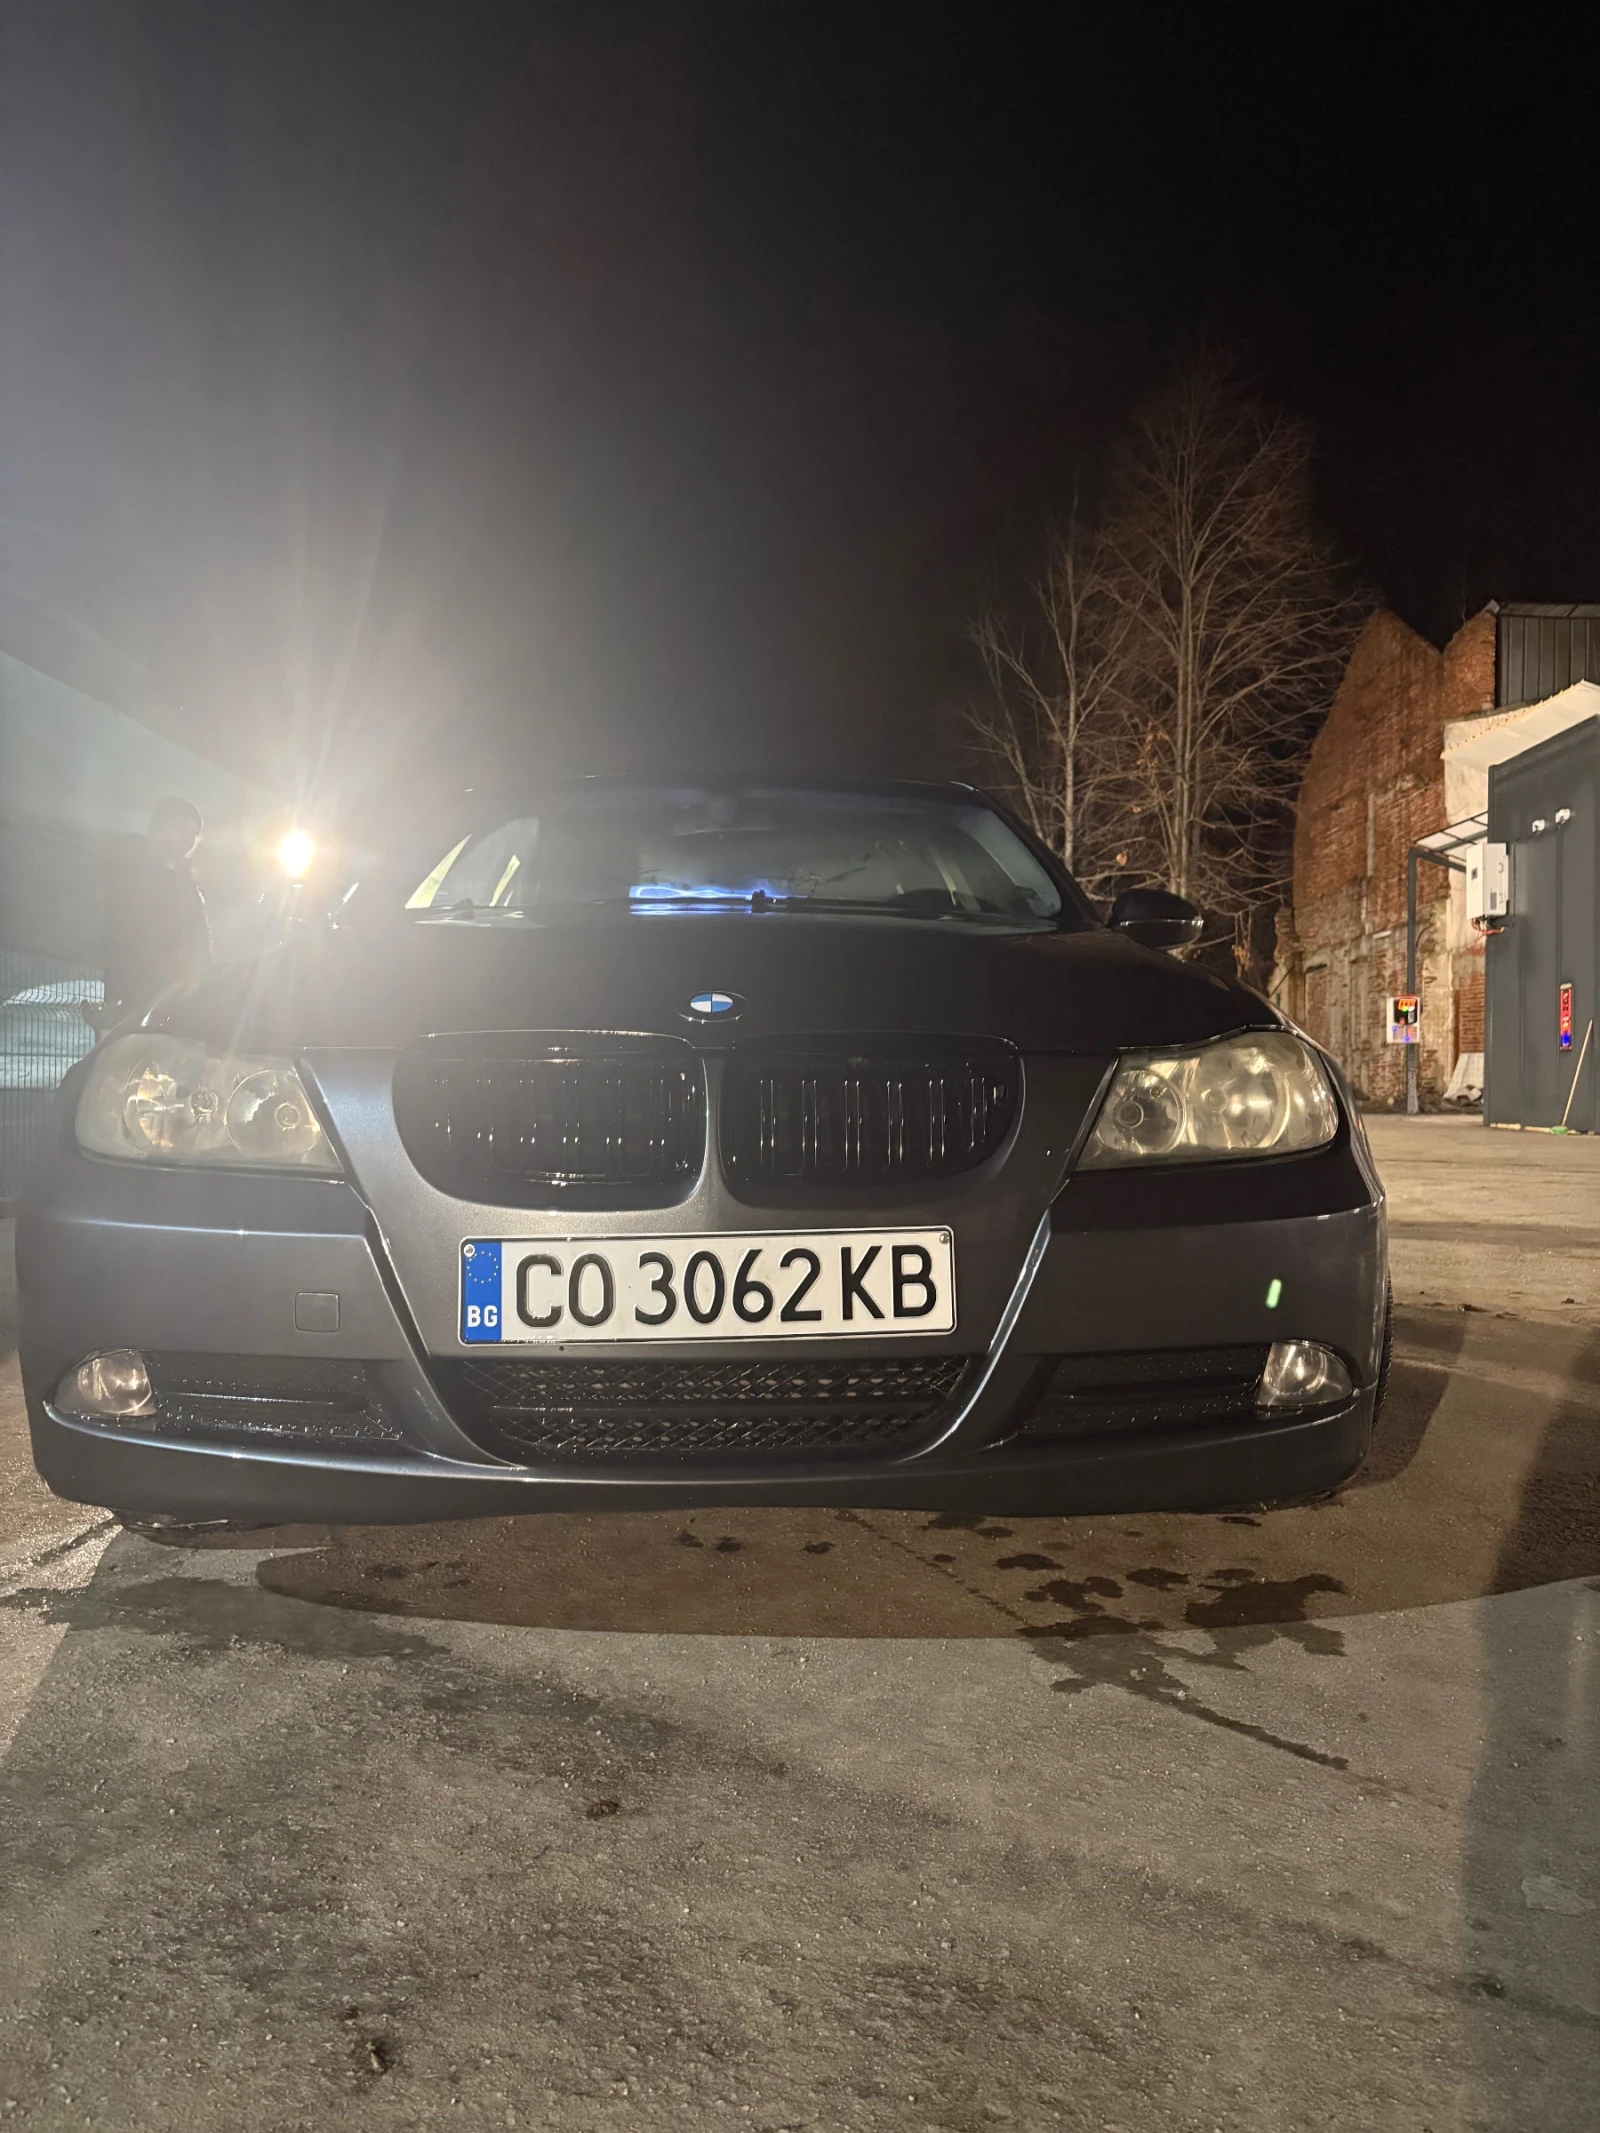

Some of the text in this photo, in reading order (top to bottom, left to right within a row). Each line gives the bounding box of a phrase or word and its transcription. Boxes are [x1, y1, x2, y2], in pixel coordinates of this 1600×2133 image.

[516, 1244, 938, 1327] CO 3062 KB
[467, 1305, 498, 1328] BG
